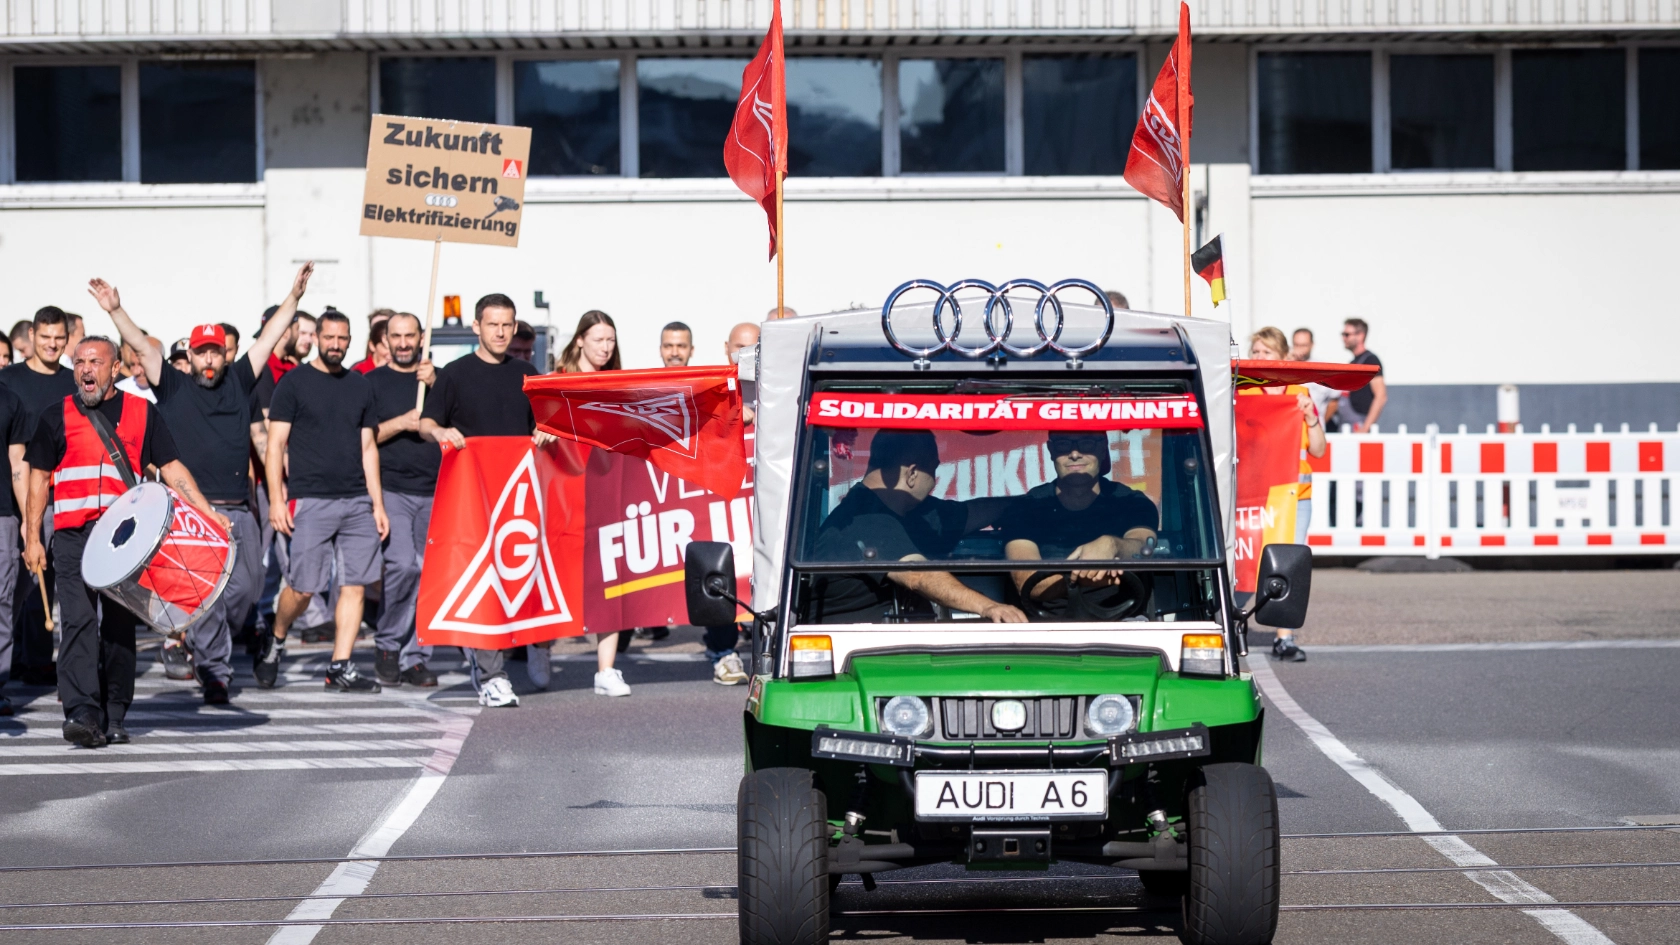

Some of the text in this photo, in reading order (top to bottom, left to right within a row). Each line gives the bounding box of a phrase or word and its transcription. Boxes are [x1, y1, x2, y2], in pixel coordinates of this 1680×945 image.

[383, 122, 503, 156] Zukunft
[386, 164, 498, 195] sichern
[363, 203, 517, 238] Elektrifizierung
[818, 398, 1199, 420] SOLIDARITÄT GEWINNT!
[1235, 505, 1275, 531] TEN
[598, 500, 697, 583] FÜR
[936, 780, 1014, 809] AUDI
